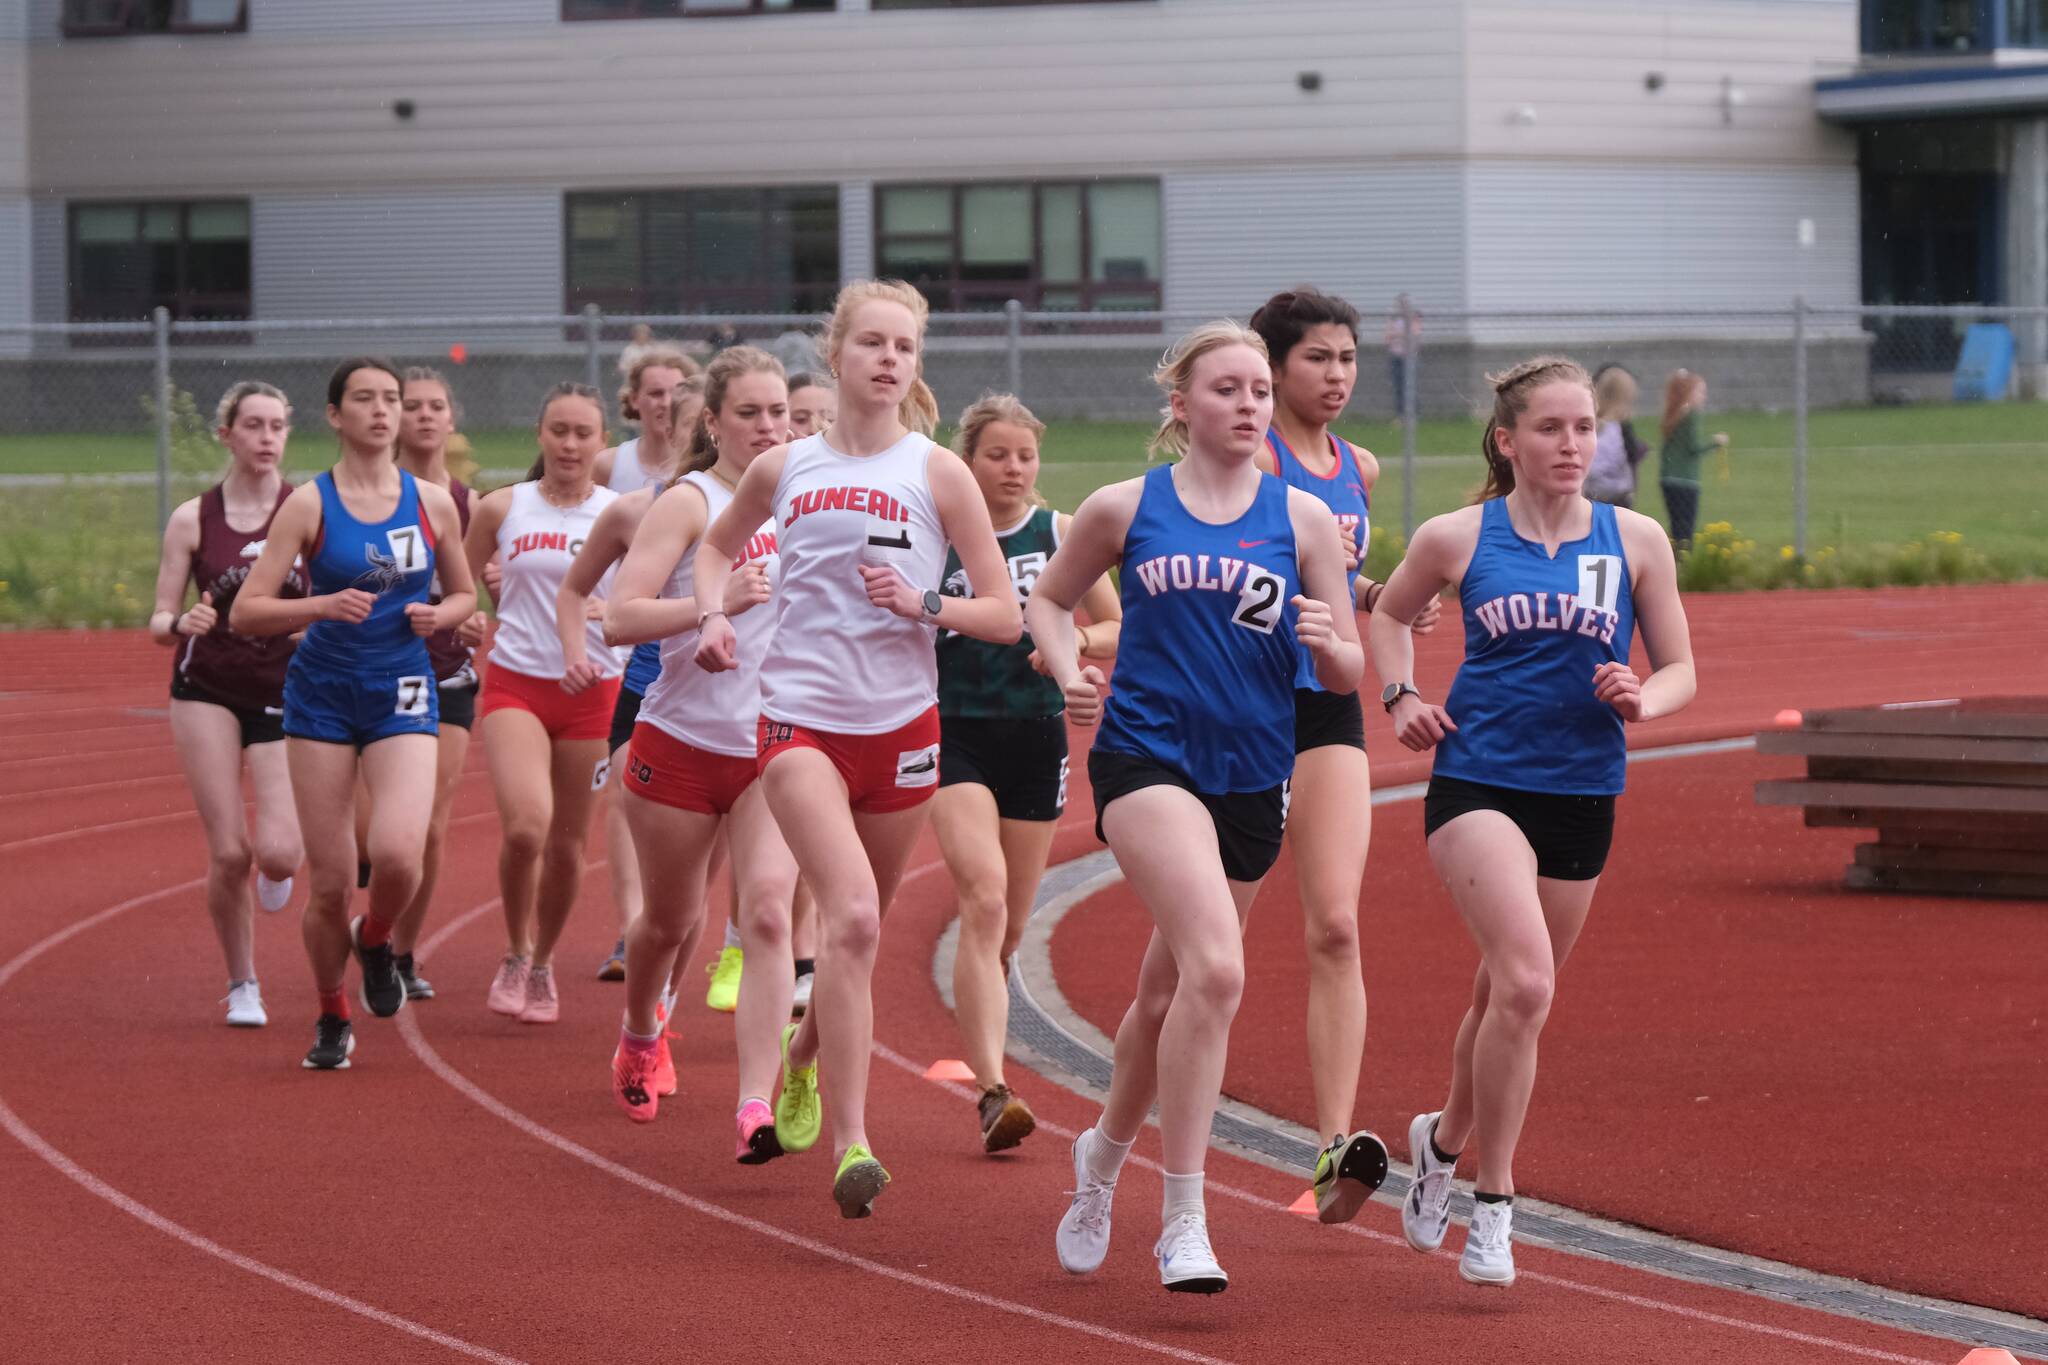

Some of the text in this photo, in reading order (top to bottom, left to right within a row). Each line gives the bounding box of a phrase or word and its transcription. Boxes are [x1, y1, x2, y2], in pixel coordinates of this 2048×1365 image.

[784, 486, 909, 529] JUNEAU
[391, 530, 415, 568] 7
[867, 529, 912, 550] 1
[1016, 556, 1041, 597] 5
[1586, 558, 1607, 608] 1
[1238, 576, 1279, 628] 2
[1474, 592, 1619, 644] WOLVES
[403, 681, 422, 710] 7
[900, 752, 936, 774] 1
